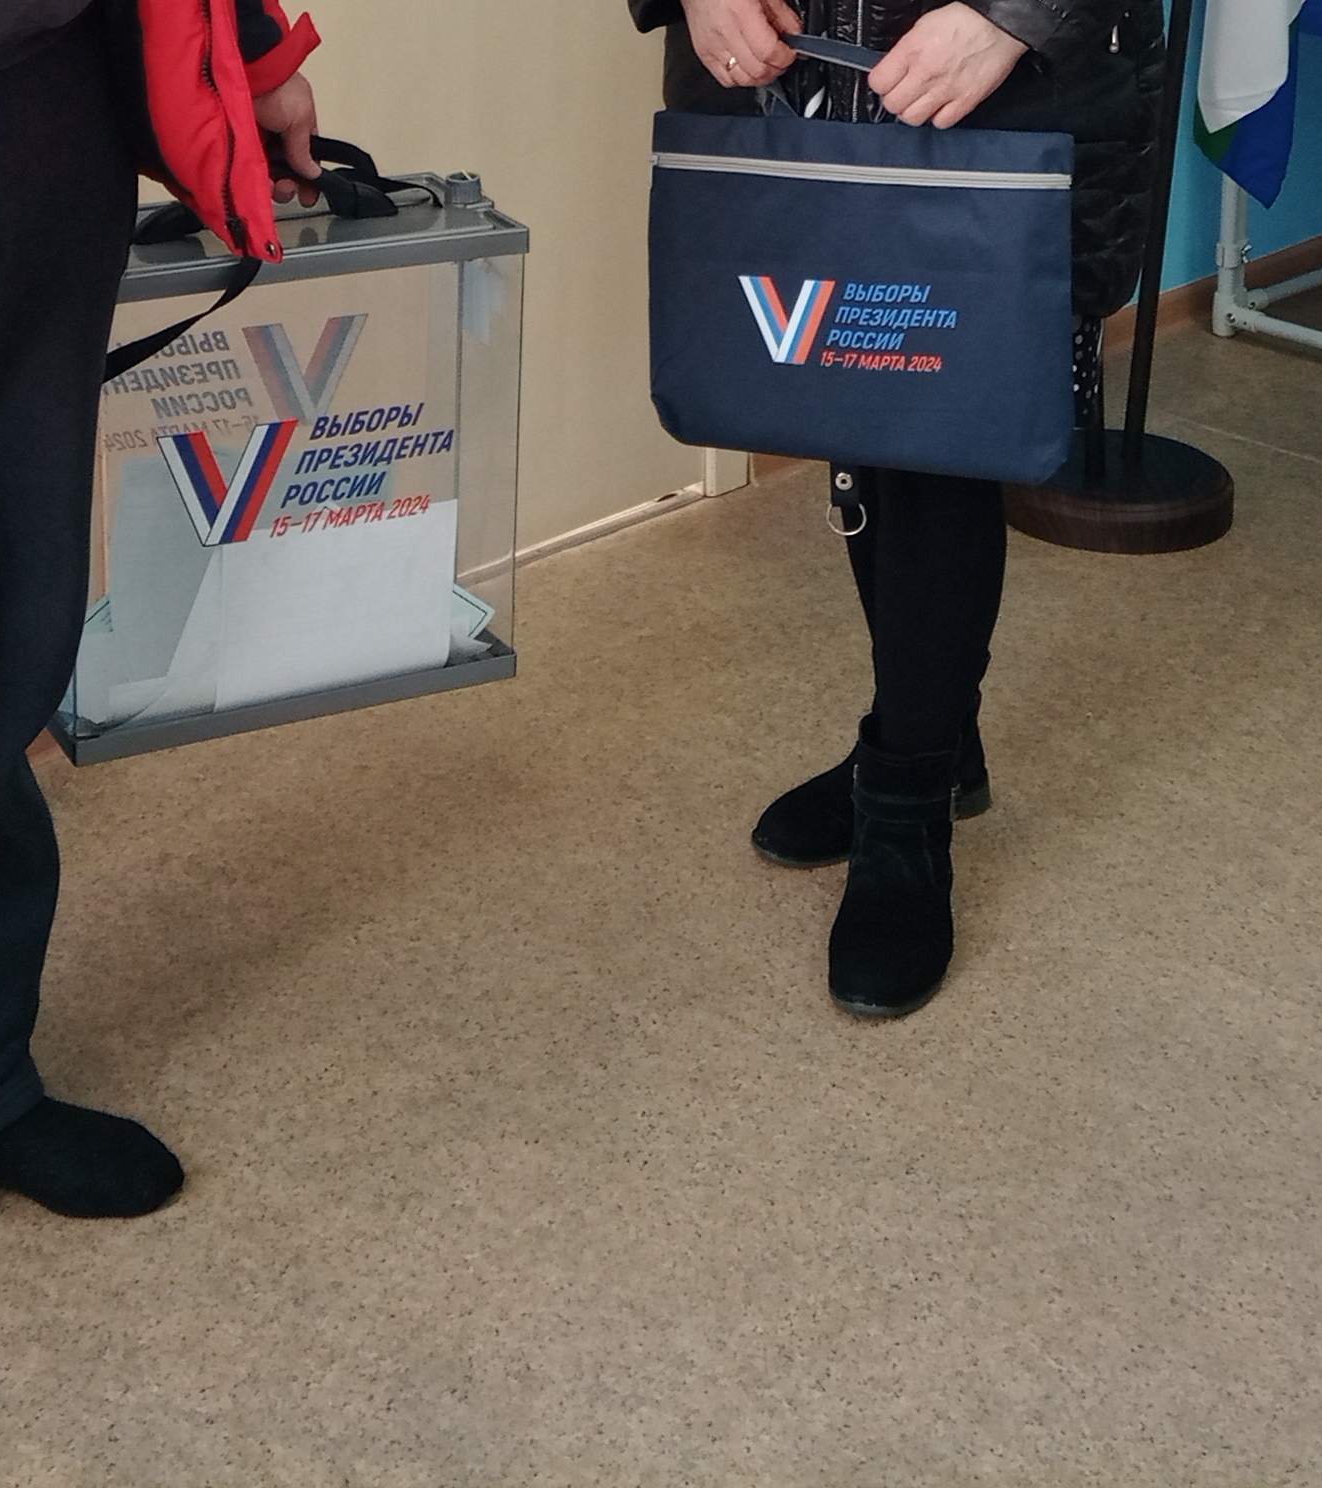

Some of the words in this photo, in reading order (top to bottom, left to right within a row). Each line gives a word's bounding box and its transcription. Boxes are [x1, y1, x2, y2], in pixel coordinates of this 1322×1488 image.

[843, 283, 931, 303] ВЫБОРЫ
[835, 307, 958, 329] ПРЕЗИДЕНТА
[827, 329, 905, 350] РОССИИ
[858, 354, 906, 371] МАРТА
[907, 356, 943, 373] 2024
[309, 403, 424, 440] ВЫБОРЫ
[295, 429, 454, 475] ПРЕЗИДЕНТА
[280, 471, 387, 508] РОССИИ
[322, 502, 385, 530] МАРТА
[386, 495, 431, 520] 2024
